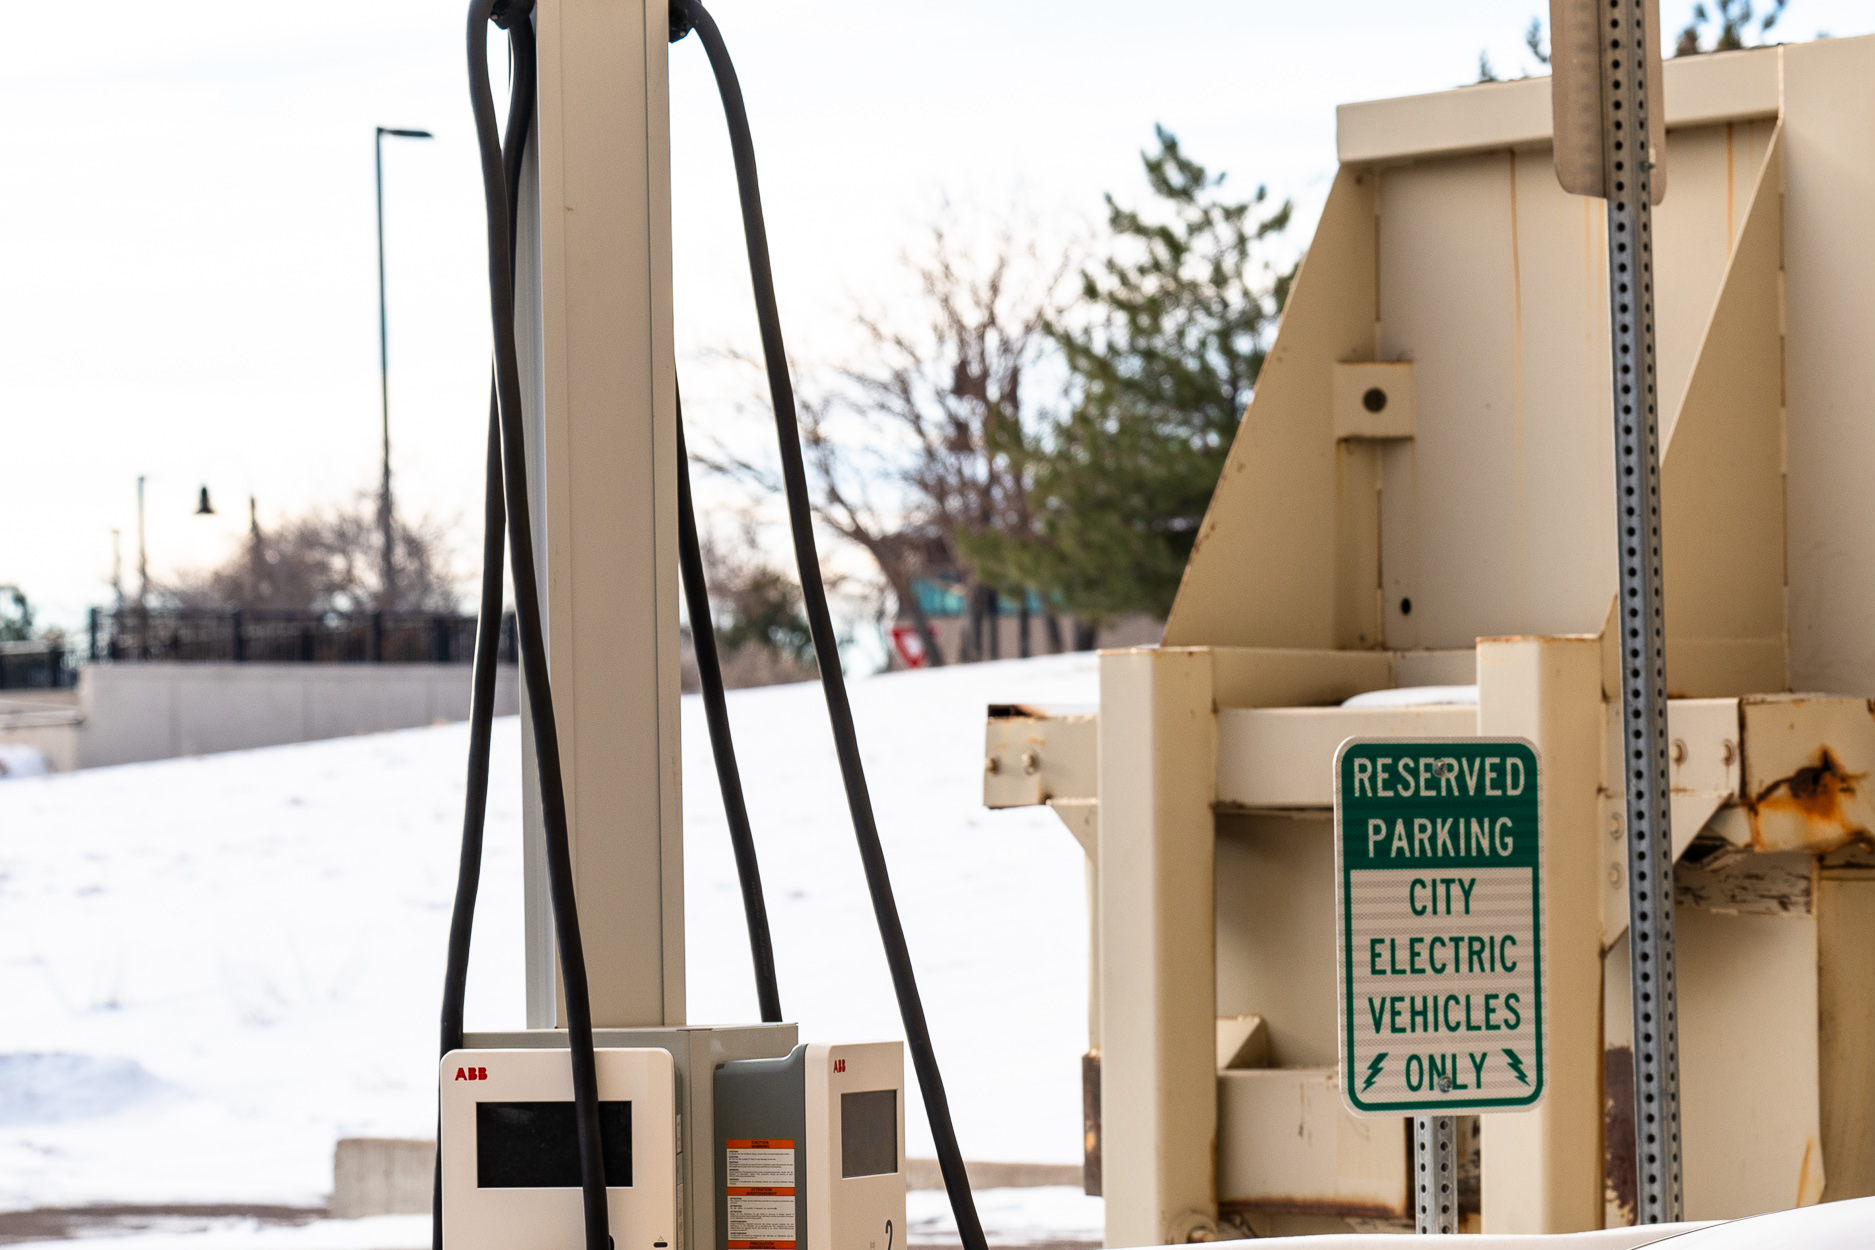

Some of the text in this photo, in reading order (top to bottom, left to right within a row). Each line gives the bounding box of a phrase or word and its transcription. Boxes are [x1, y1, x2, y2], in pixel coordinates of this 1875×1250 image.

[1353, 757, 1526, 798] RESERVED
[1367, 816, 1514, 859] PARKING
[1409, 878, 1477, 917] CITY
[1369, 934, 1518, 976] ELECTRIC
[1367, 992, 1522, 1035] VEHICLES
[454, 1066, 488, 1081] ABB
[833, 1059, 846, 1074] ABB
[1405, 1052, 1488, 1093] ONLY
